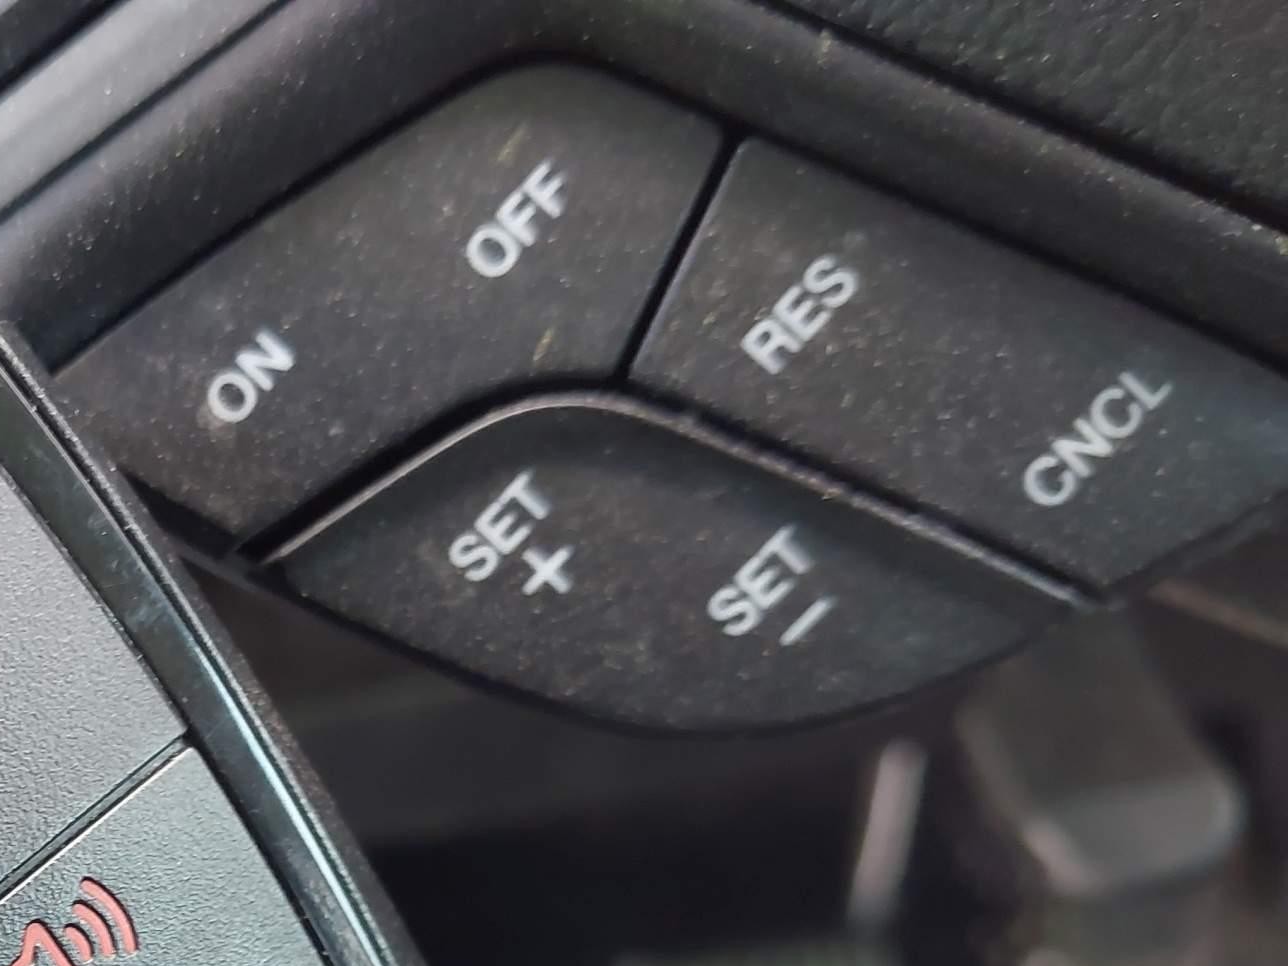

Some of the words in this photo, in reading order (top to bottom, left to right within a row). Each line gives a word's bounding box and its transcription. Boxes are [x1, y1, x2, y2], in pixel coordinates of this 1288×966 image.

[465, 159, 569, 281] OFF
[740, 252, 858, 376] RES
[206, 329, 298, 425] ON
[1022, 366, 1174, 509] CNCL
[447, 468, 553, 585] SET
[706, 523, 816, 638] SET
